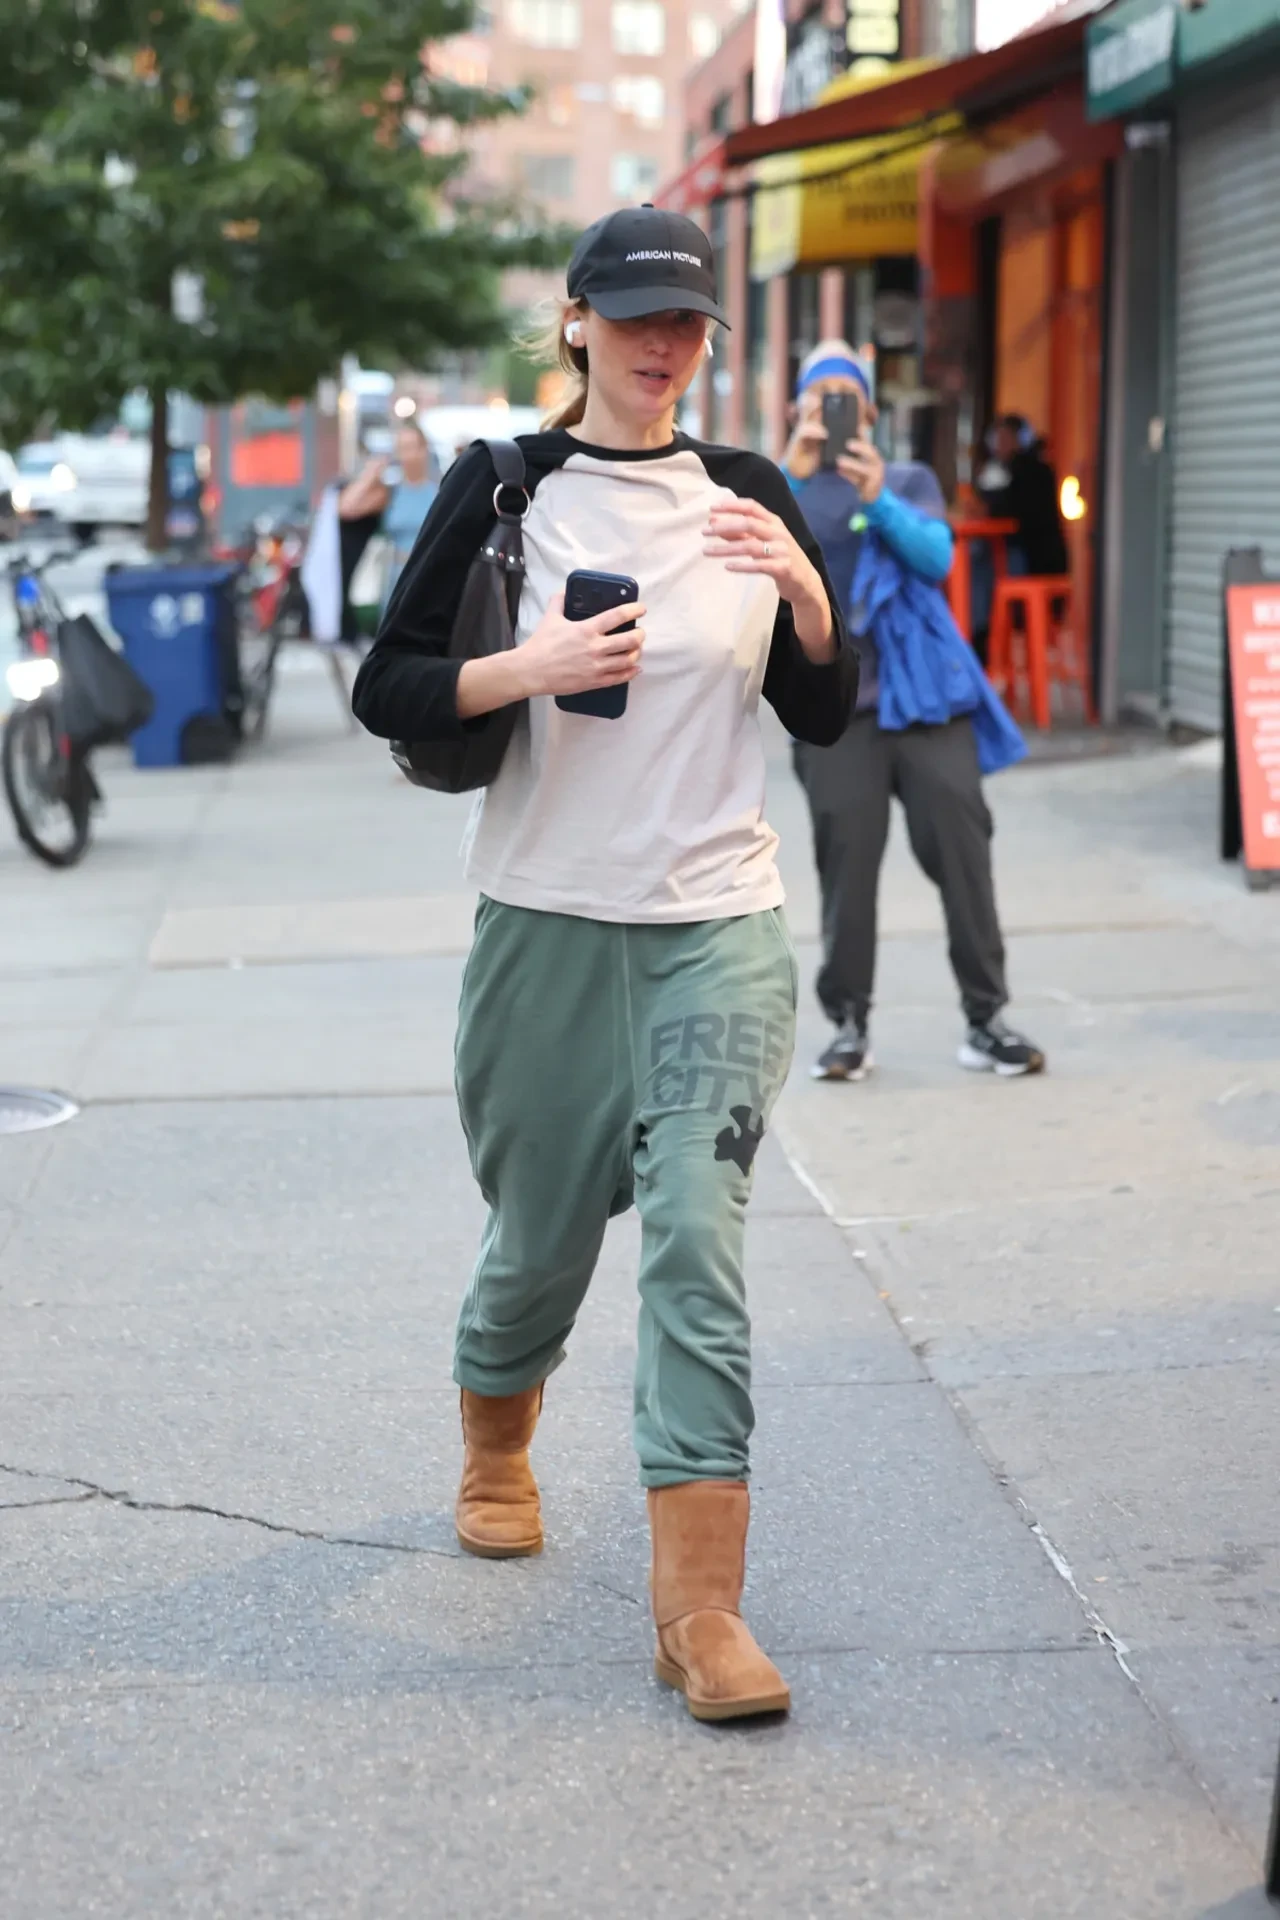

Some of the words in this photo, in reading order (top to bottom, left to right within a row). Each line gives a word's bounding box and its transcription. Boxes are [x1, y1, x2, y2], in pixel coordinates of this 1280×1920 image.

[625, 250, 671, 262] AMERICAN
[651, 1012, 786, 1078] FREE
[652, 1065, 772, 1132] CITY
